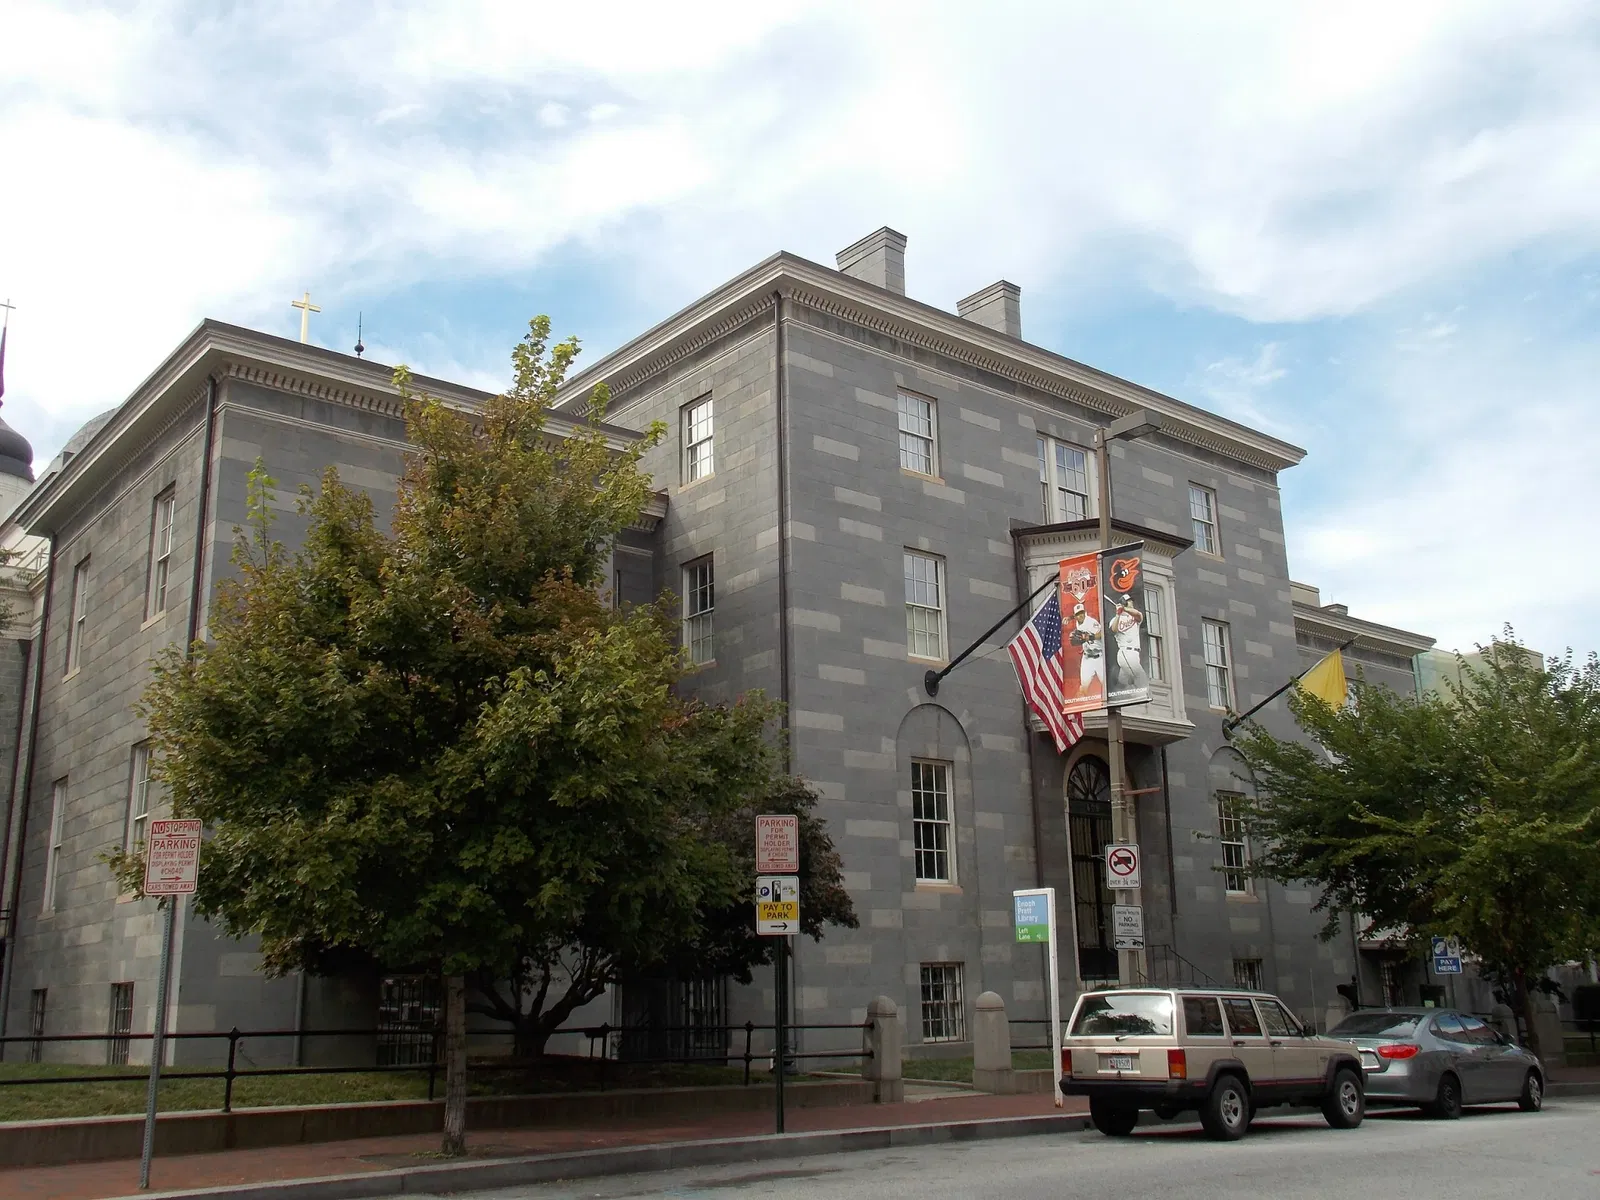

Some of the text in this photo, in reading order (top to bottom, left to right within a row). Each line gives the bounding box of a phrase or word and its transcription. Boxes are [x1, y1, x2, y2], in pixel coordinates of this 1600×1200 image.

[1072, 578, 1088, 593] 60
[153, 822, 200, 834] NO STOPPING
[153, 839, 196, 850] PARKING
[153, 851, 163, 859] FOR
